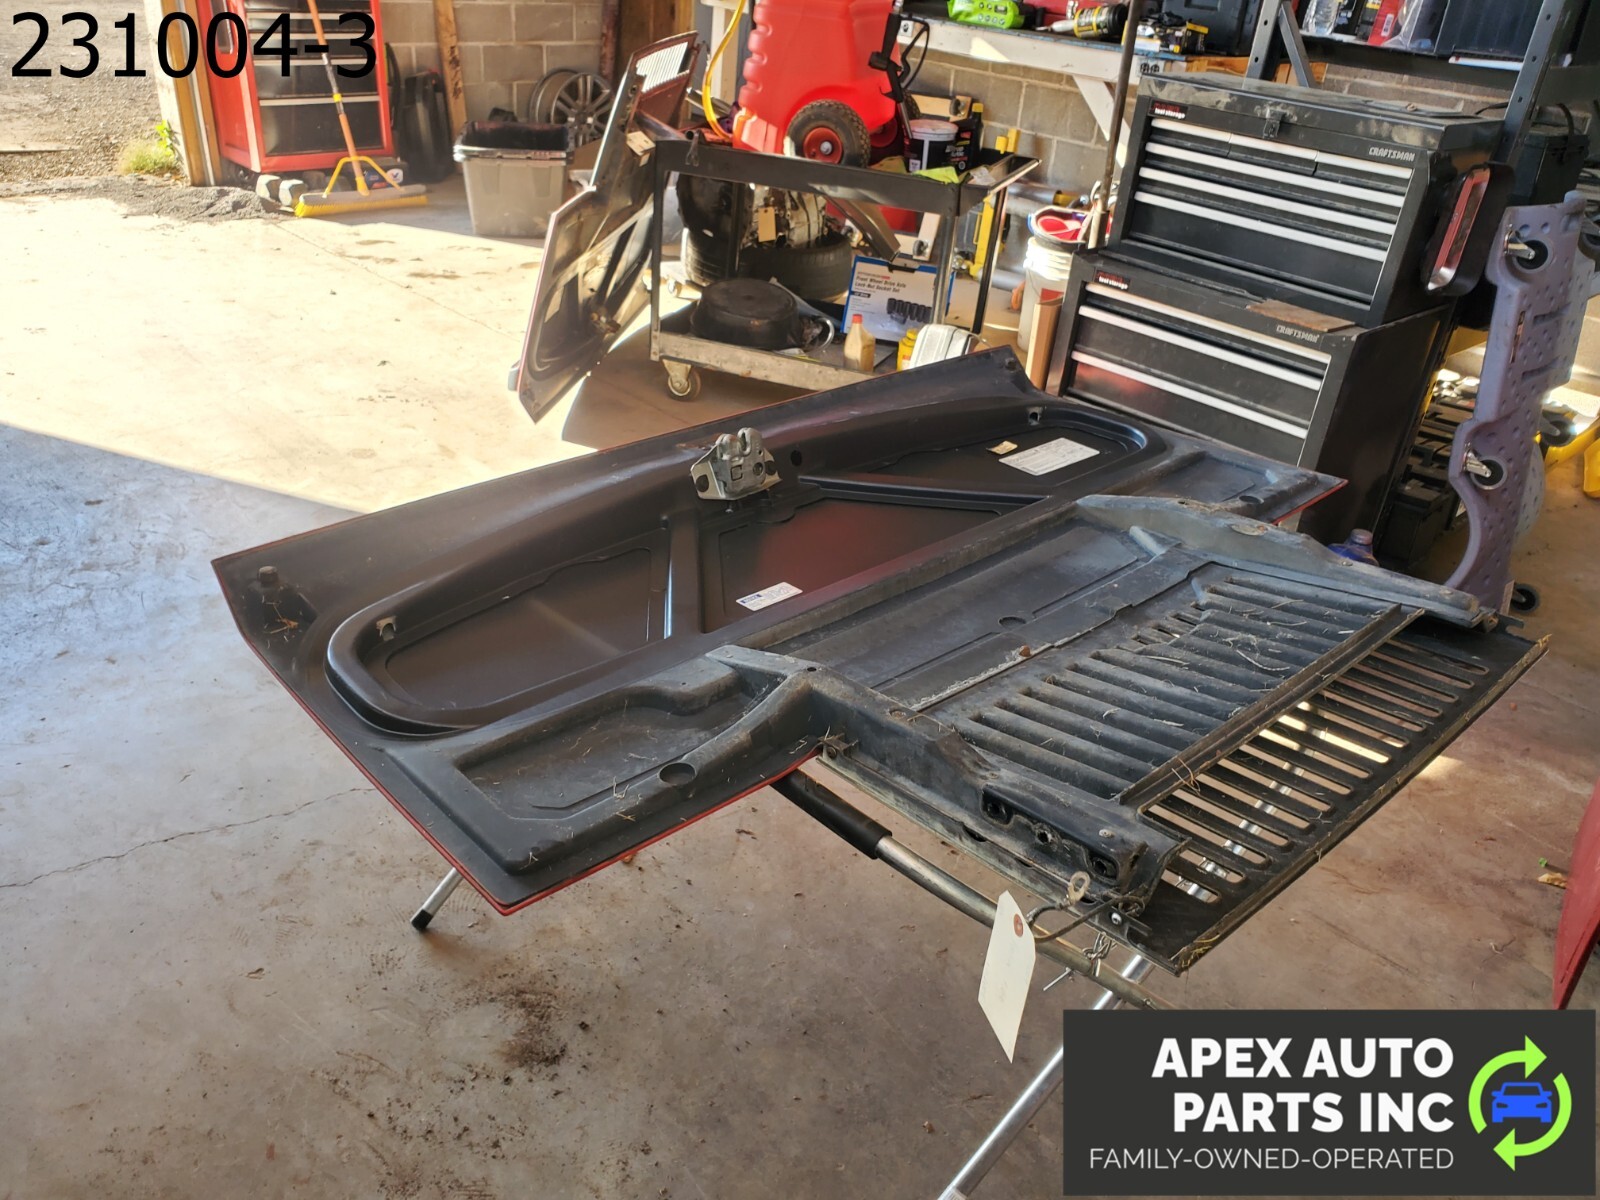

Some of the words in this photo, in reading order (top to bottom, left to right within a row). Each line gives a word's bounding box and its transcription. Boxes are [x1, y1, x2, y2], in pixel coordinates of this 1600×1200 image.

[1165, 109, 1186, 119] storage
[1368, 146, 1416, 162] CRAFTSMAN
[1109, 279, 1129, 290] storage
[1276, 324, 1320, 343] CRAFTSMAN
